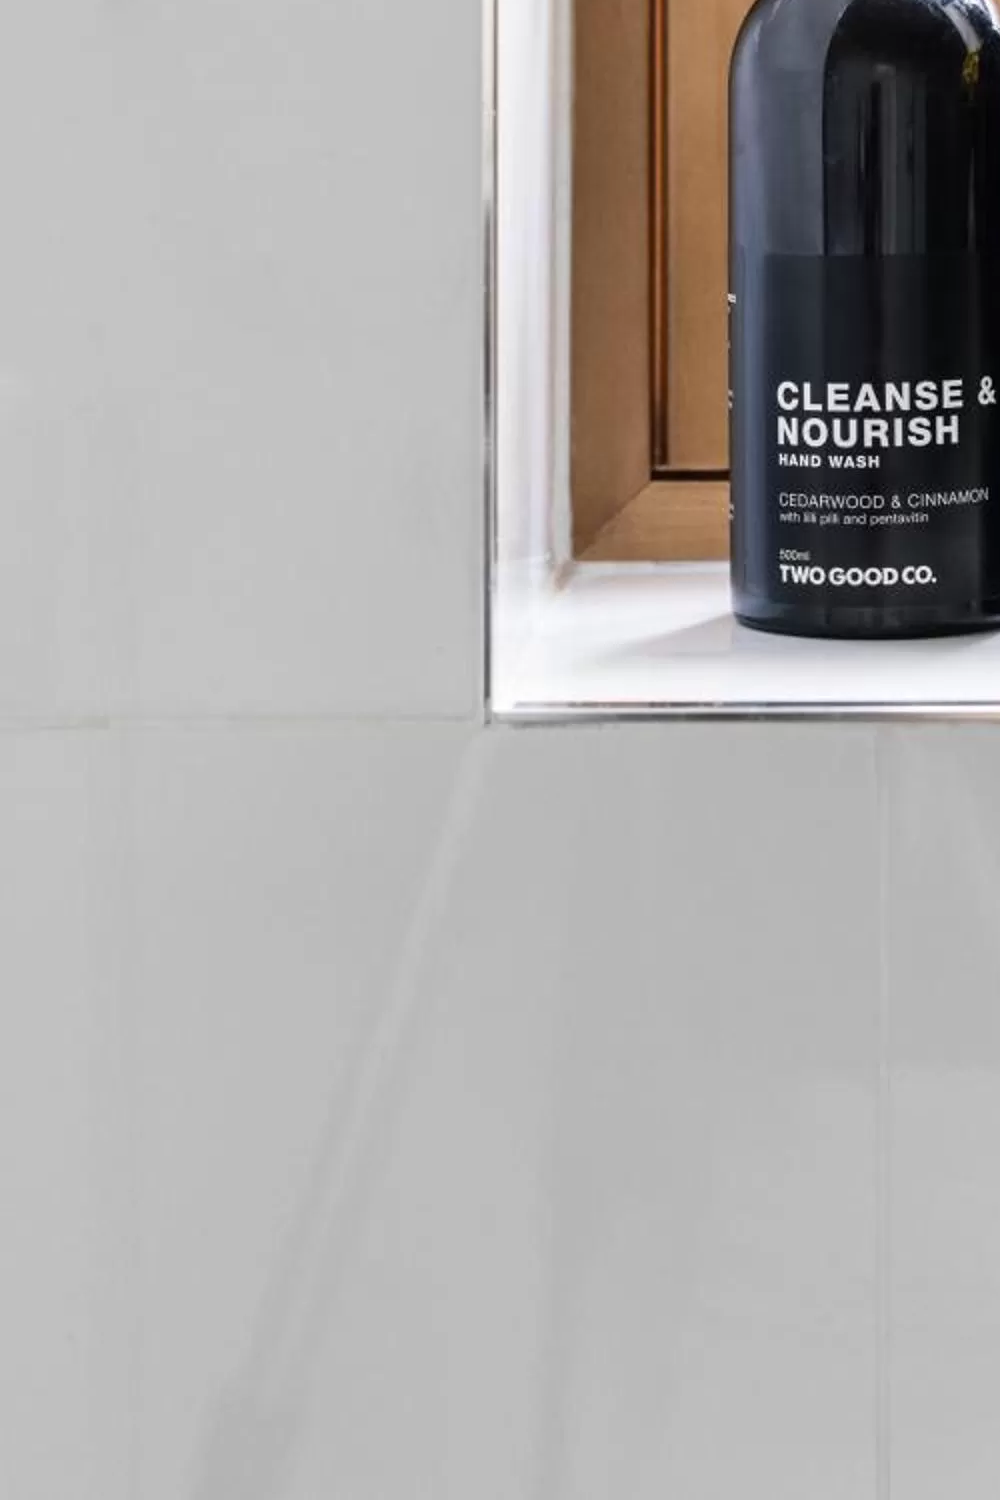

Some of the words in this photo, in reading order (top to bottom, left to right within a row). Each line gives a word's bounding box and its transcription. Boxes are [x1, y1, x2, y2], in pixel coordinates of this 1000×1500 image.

[776, 379, 964, 413] CLEANSE
[977, 375, 997, 405] &
[777, 414, 959, 449] NOURISH
[778, 453, 822, 468] HAND
[827, 455, 880, 469] WASH
[779, 492, 885, 509] CEDARWOOD
[891, 494, 901, 509] &
[907, 488, 989, 509] CINNAMON
[779, 511, 801, 523] with
[843, 513, 867, 525] and
[869, 511, 929, 526] pentavitin
[779, 563, 827, 585] TWO
[828, 567, 899, 586] GOOD
[901, 565, 937, 585] CO.
